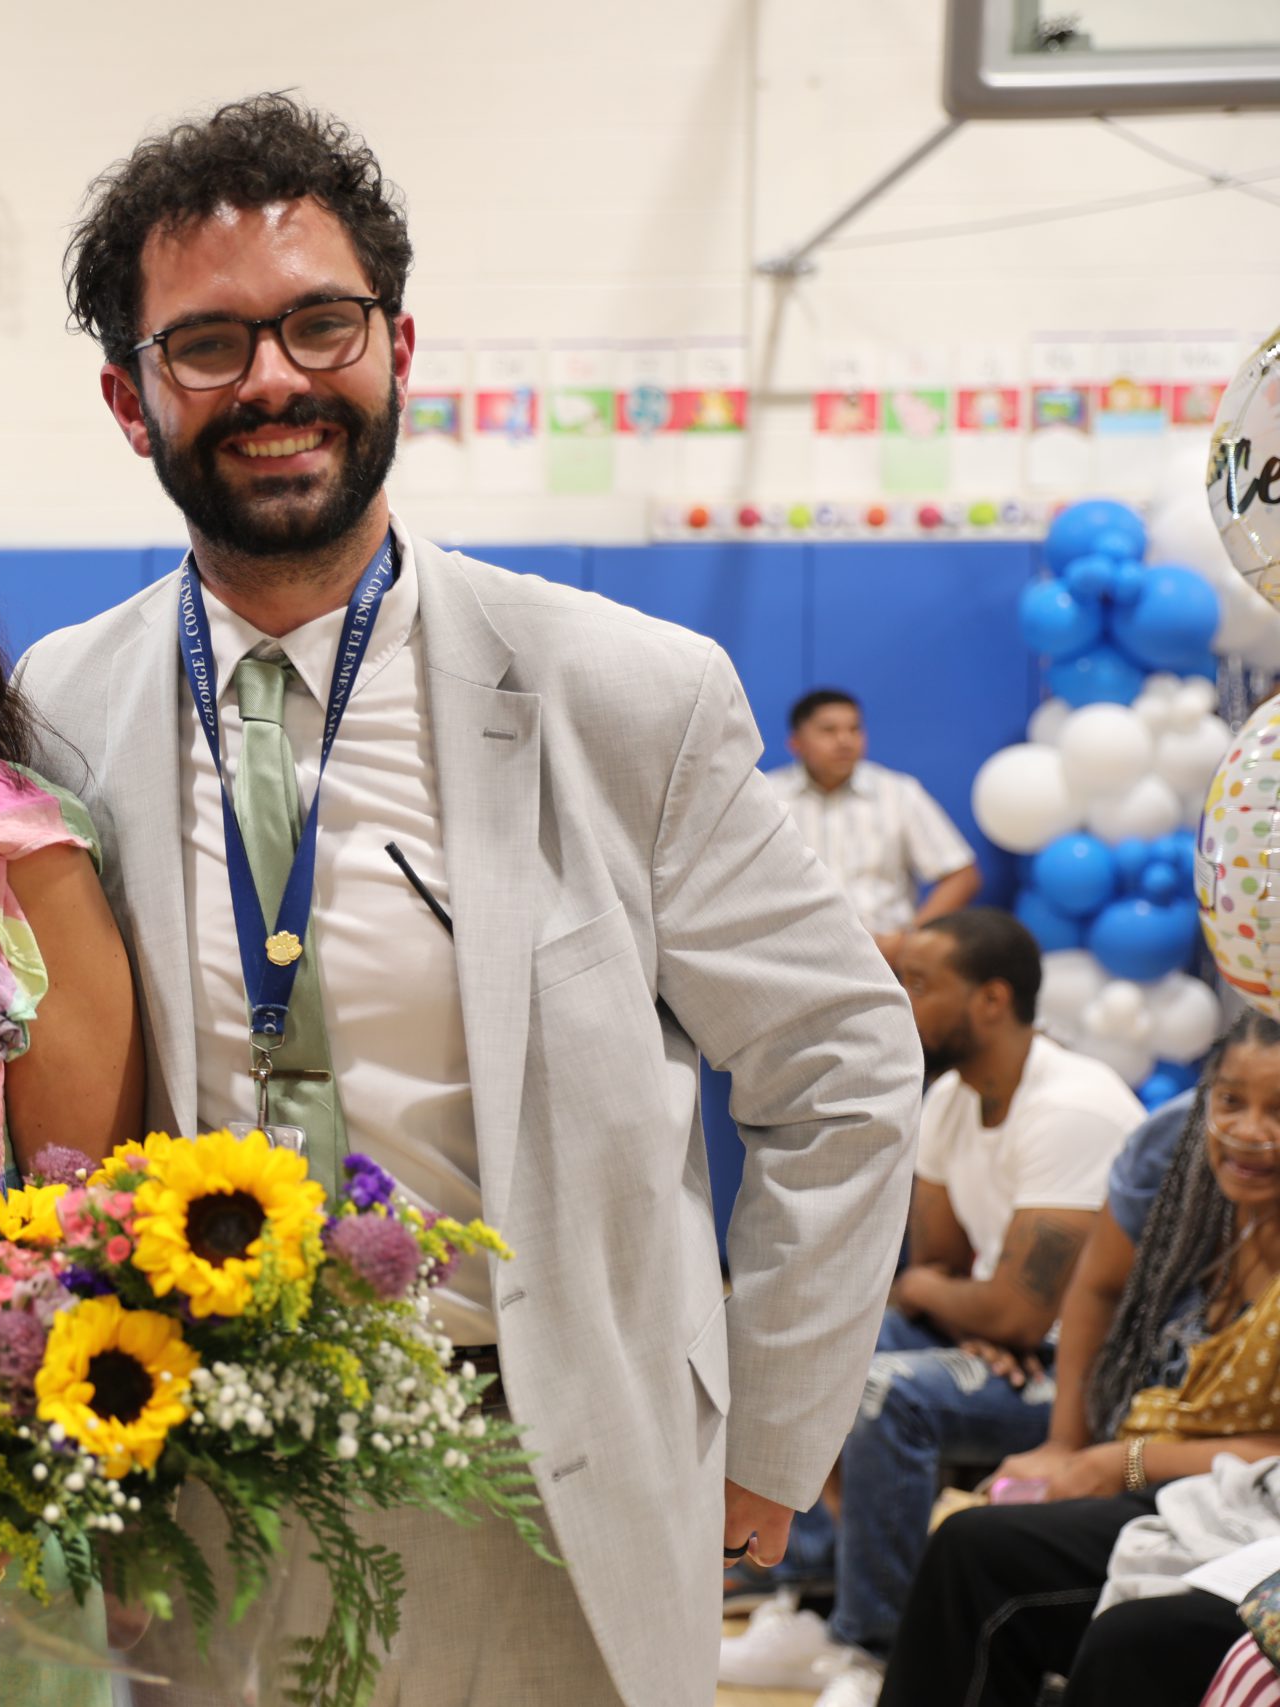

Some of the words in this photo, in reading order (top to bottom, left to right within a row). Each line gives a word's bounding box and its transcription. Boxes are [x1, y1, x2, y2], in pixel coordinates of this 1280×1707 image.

[180, 578, 199, 637] COOKE
[353, 578, 383, 627] COOKE
[190, 639, 203, 655] L.
[192, 657, 215, 727] GEORGE
[325, 629, 364, 746] ELEMENTARY
